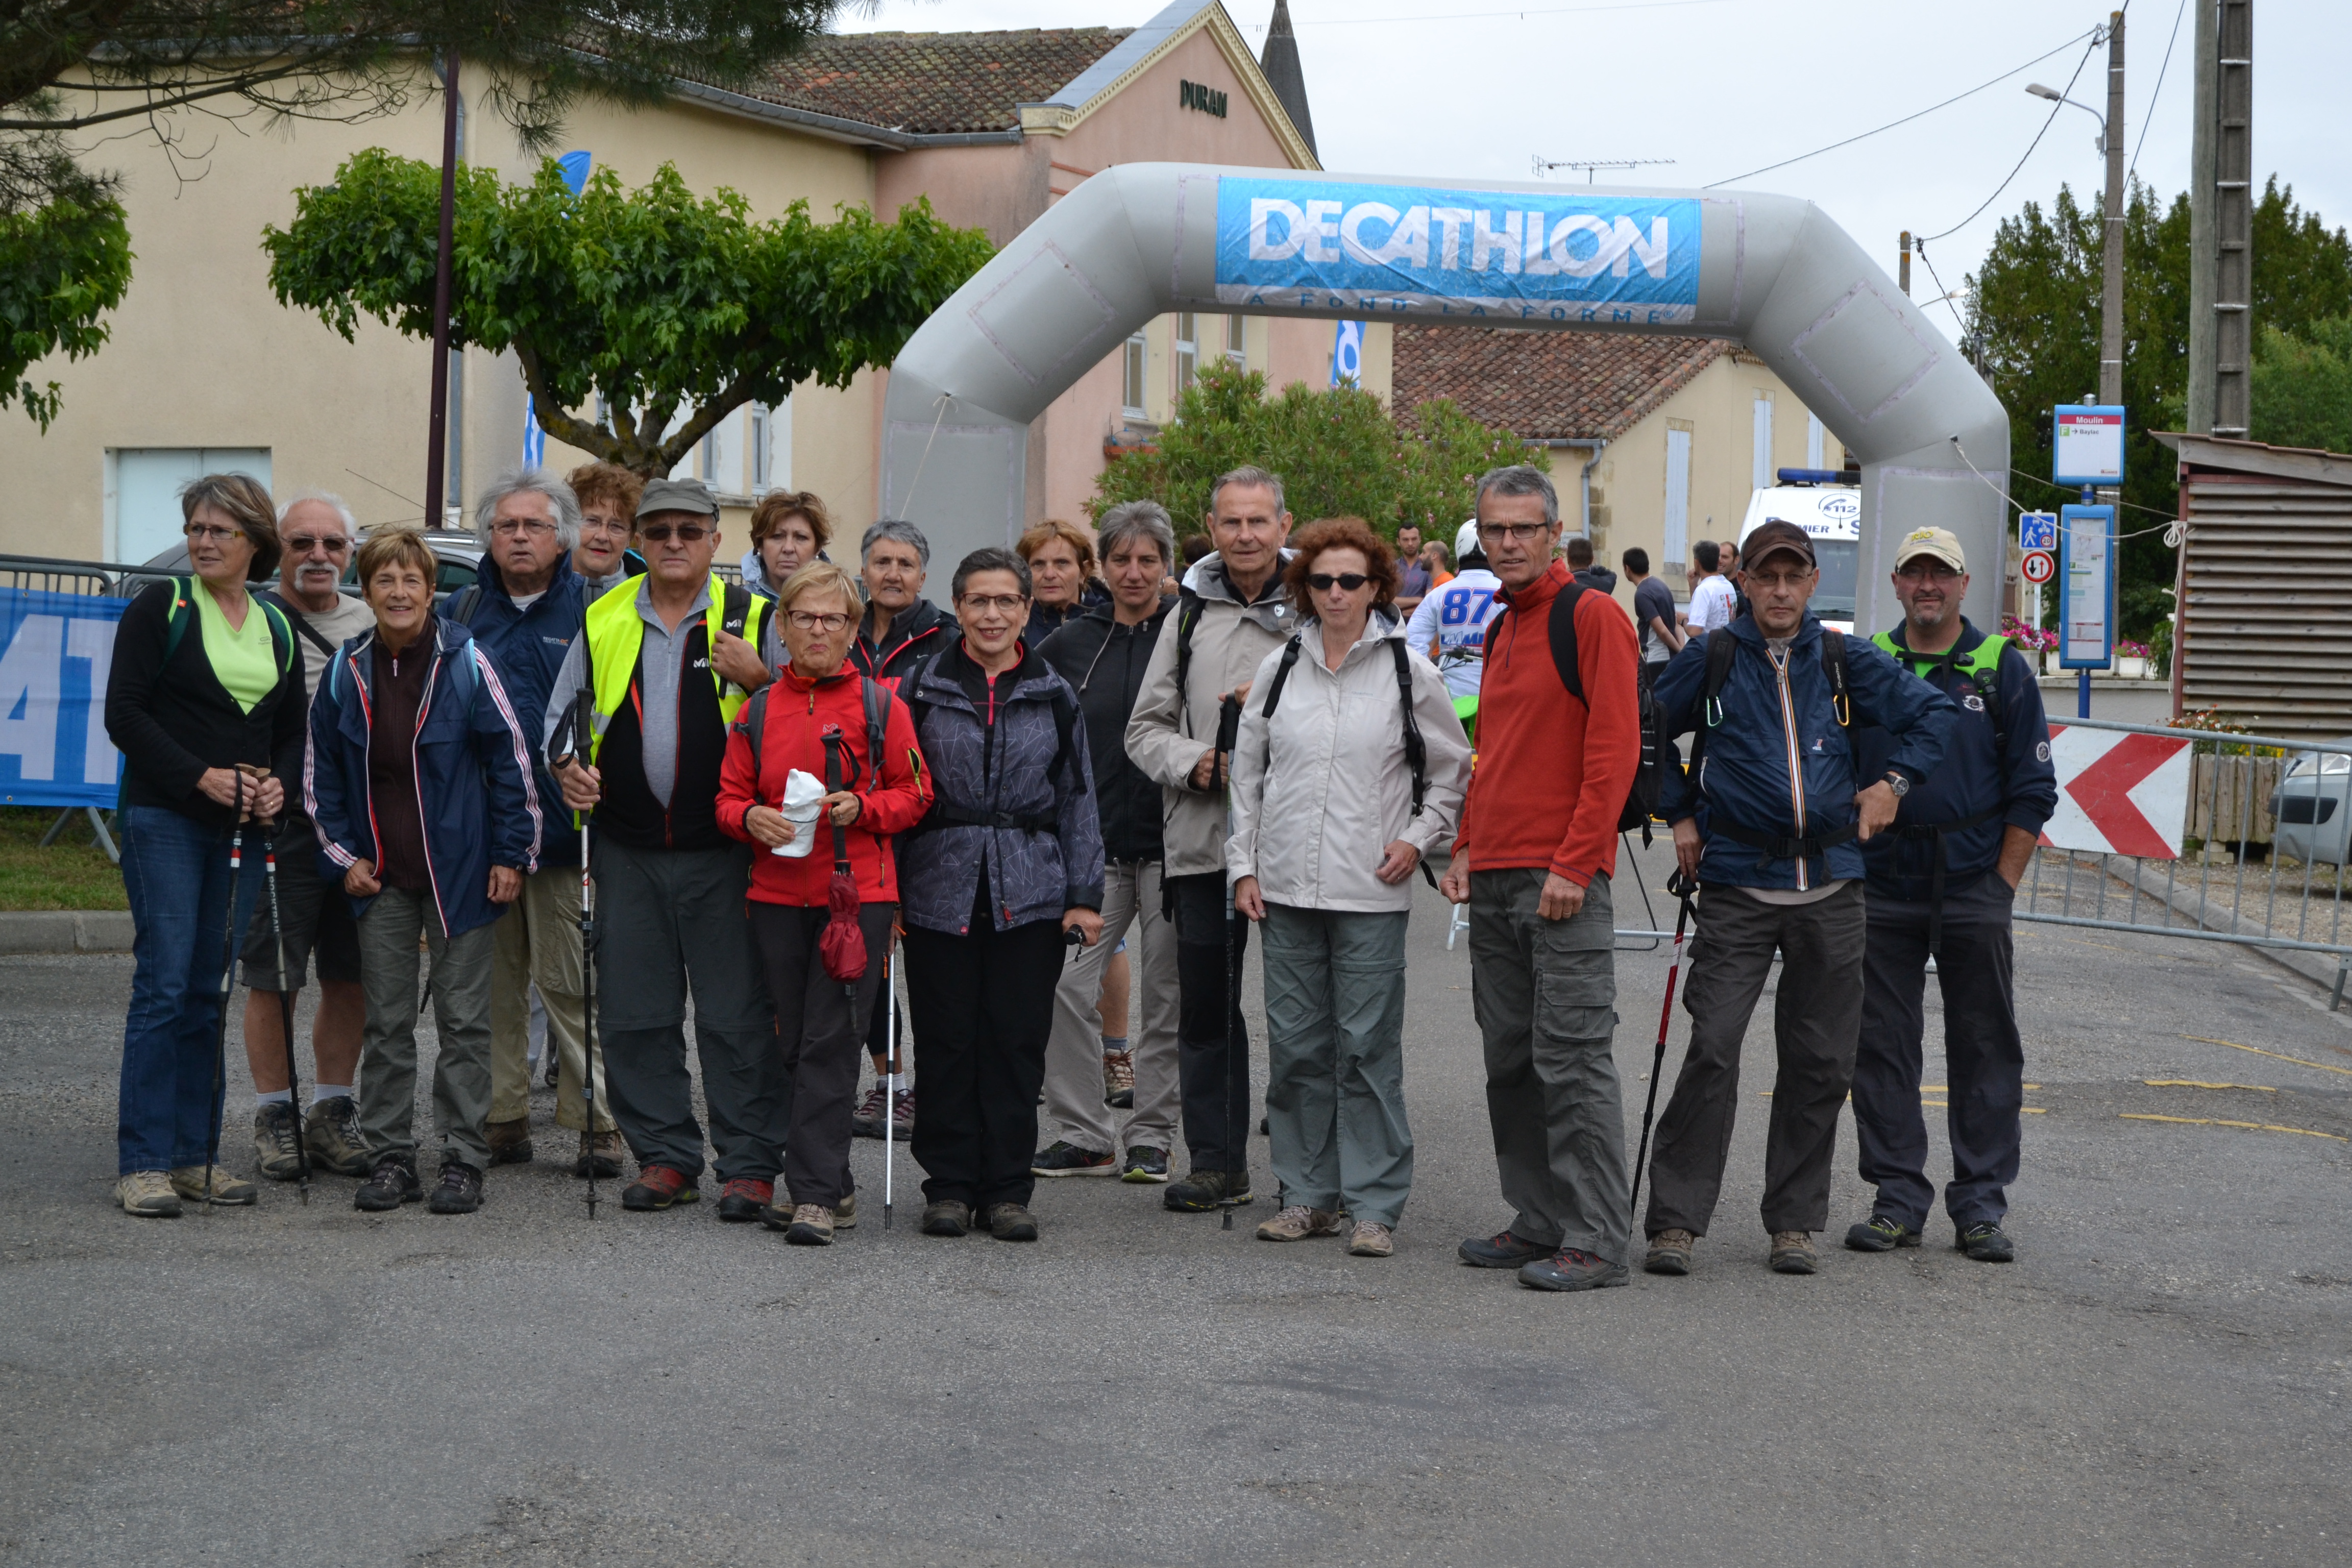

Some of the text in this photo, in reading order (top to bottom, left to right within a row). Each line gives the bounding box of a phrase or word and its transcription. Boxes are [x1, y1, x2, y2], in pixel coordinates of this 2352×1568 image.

[1180, 79, 1227, 118] DURAN
[1249, 198, 1668, 279] DECATHLON
[1248, 293, 1265, 305] A
[1300, 292, 1407, 311] FOND
[1442, 303, 1486, 315] LA
[1911, 531, 1933, 542] RIO
[1441, 586, 1498, 627] 87
